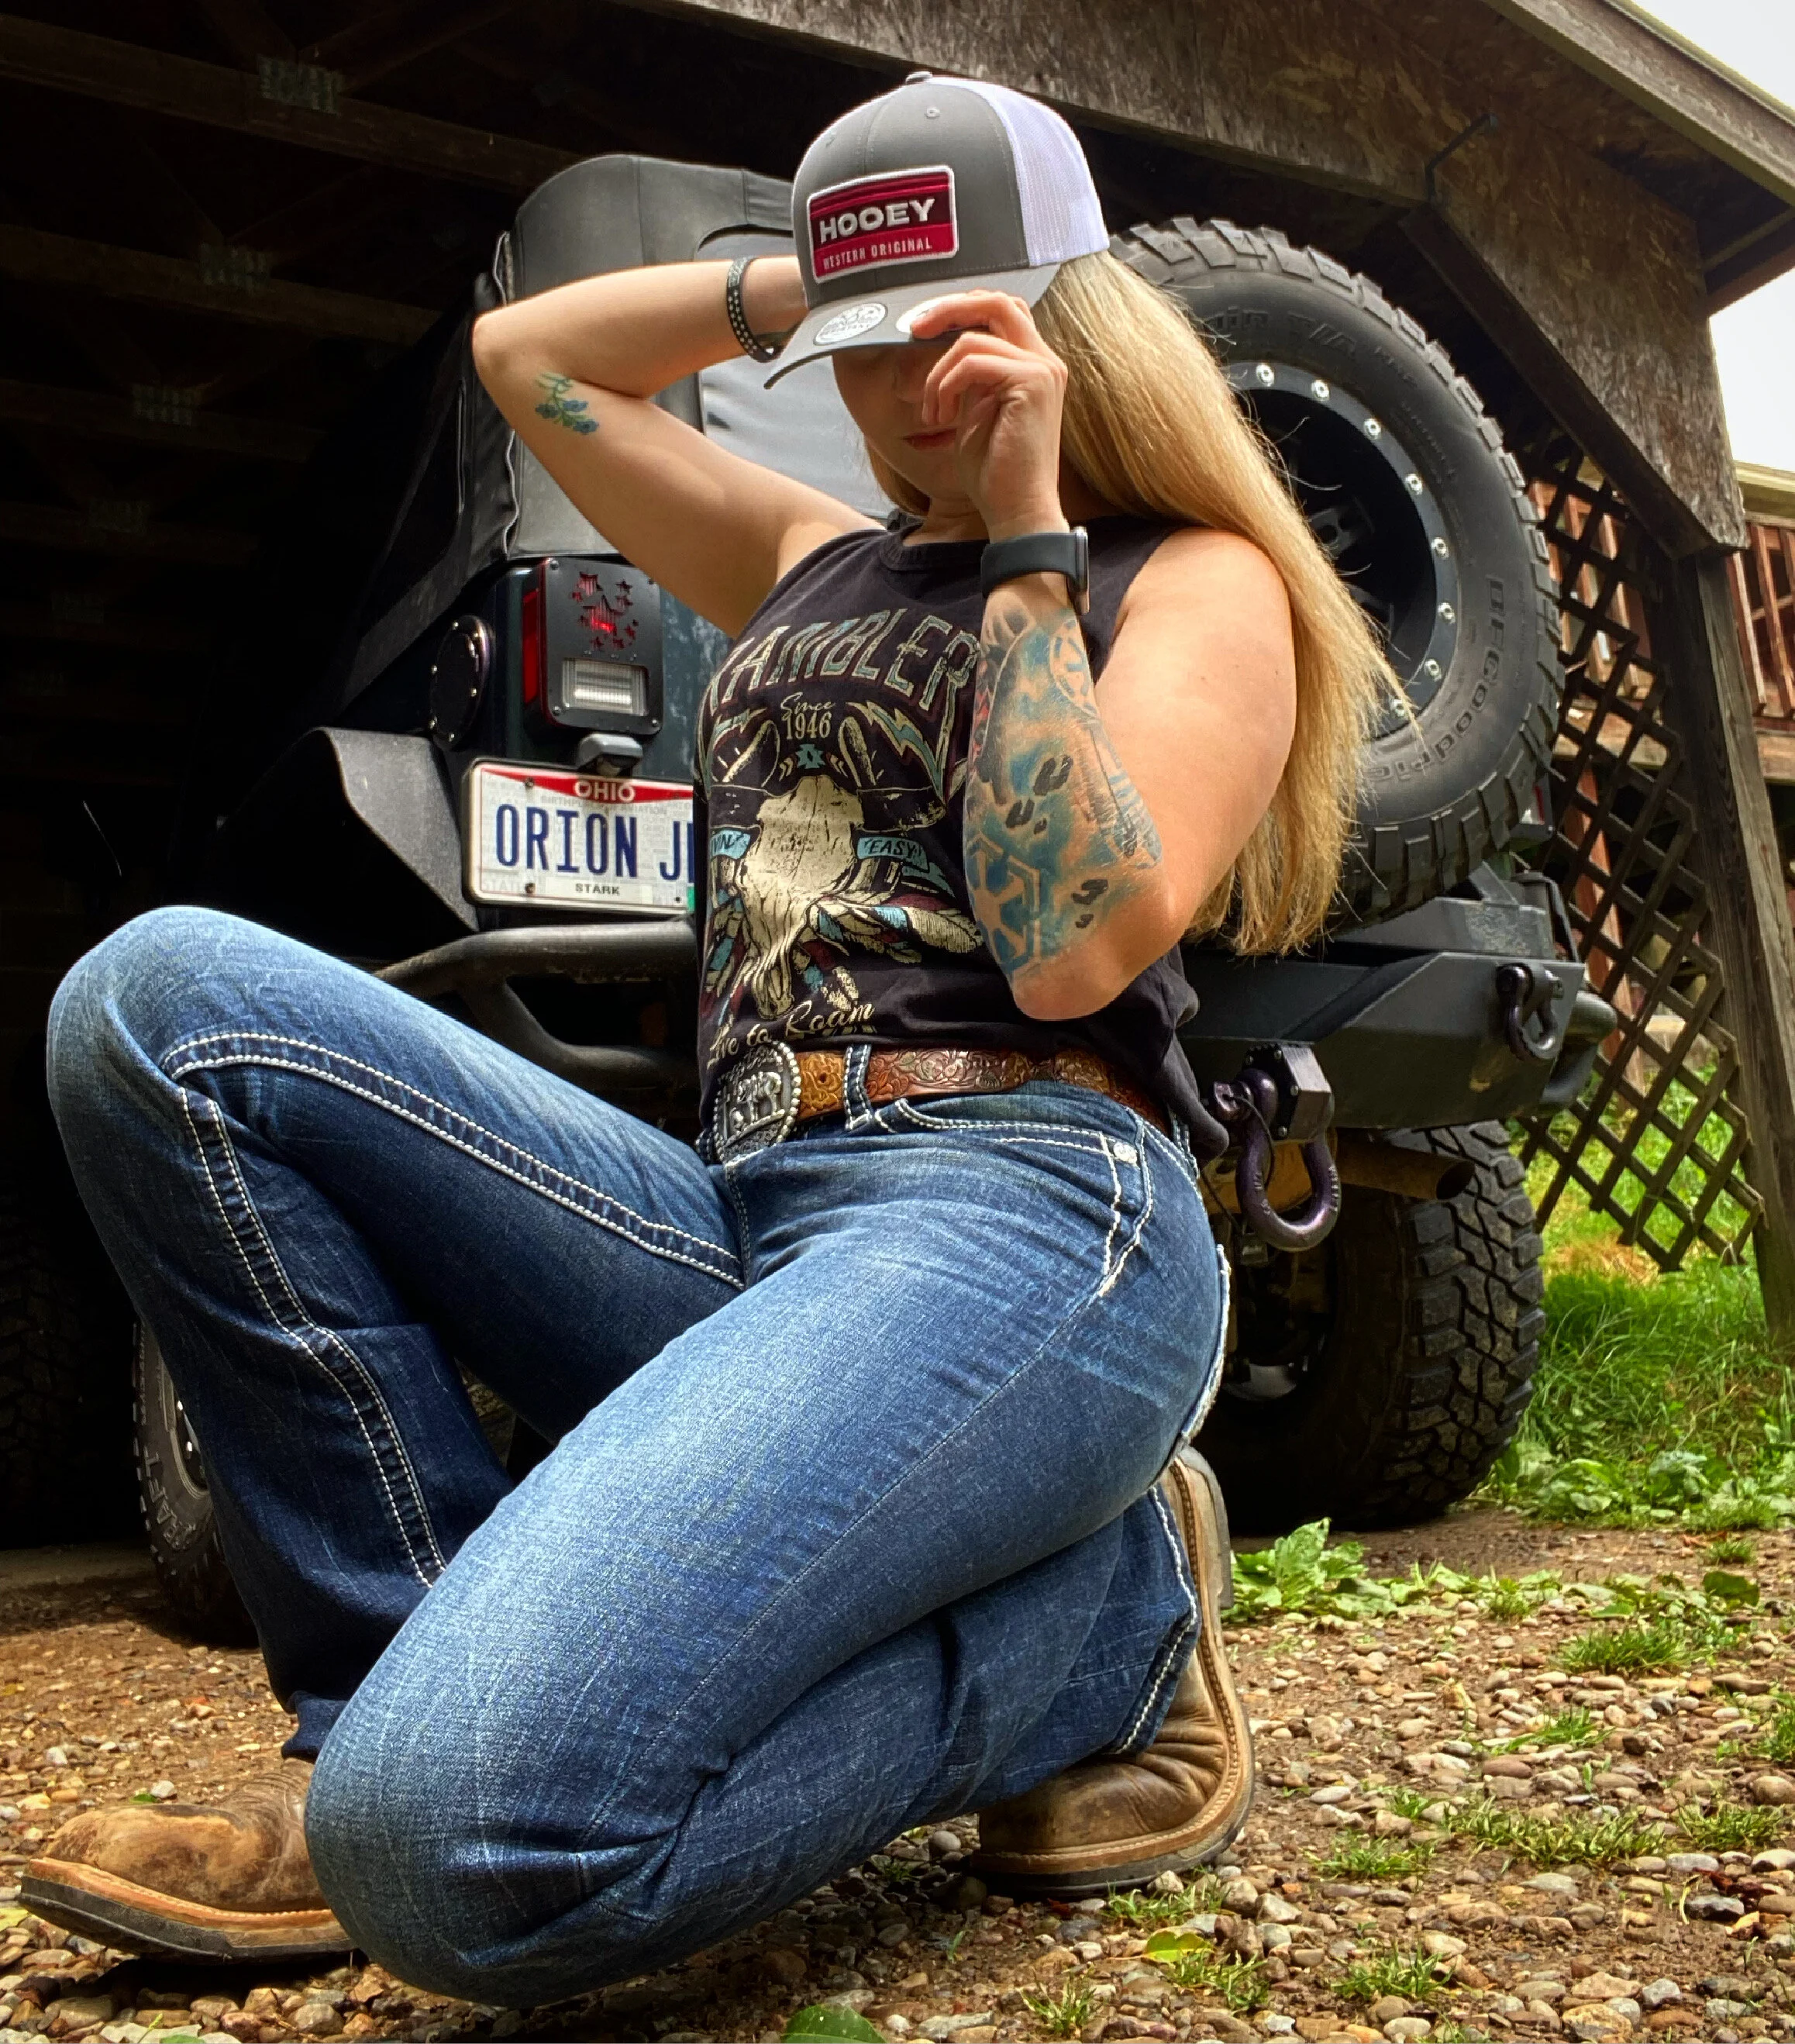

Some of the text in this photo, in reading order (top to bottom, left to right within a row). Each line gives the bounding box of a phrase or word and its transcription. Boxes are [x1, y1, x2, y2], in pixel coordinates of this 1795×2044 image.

[819, 198, 936, 244] HOOEY
[822, 236, 932, 270] WESTERN ORIGINAL
[780, 691, 836, 721] Since
[786, 711, 832, 740] 1946
[574, 780, 637, 802] OHIO
[495, 803, 638, 877] ORION
[575, 882, 620, 895] STARK
[746, 1022, 772, 1046] to
[782, 999, 876, 1037] Roam
